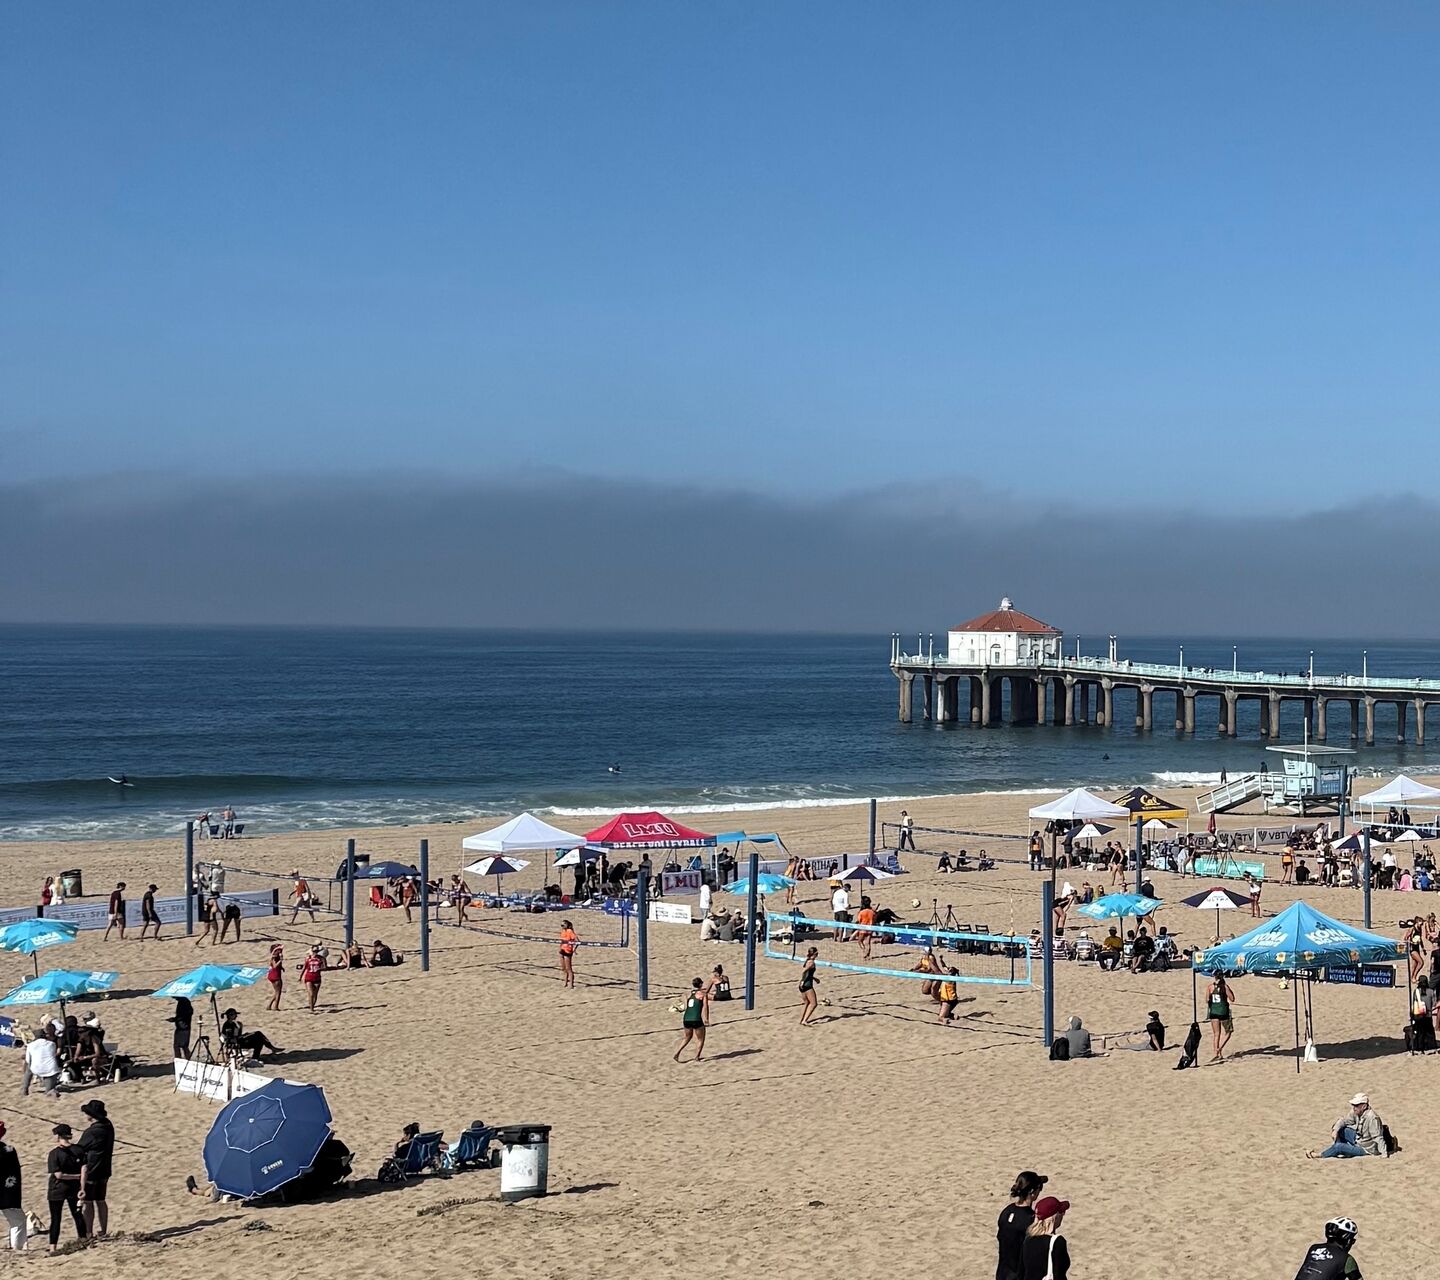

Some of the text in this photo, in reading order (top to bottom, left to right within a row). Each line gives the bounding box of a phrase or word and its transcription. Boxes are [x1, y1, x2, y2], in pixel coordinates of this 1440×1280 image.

[1140, 795, 1161, 807] Cal
[622, 822, 680, 838] LMU
[664, 874, 699, 892] LMU
